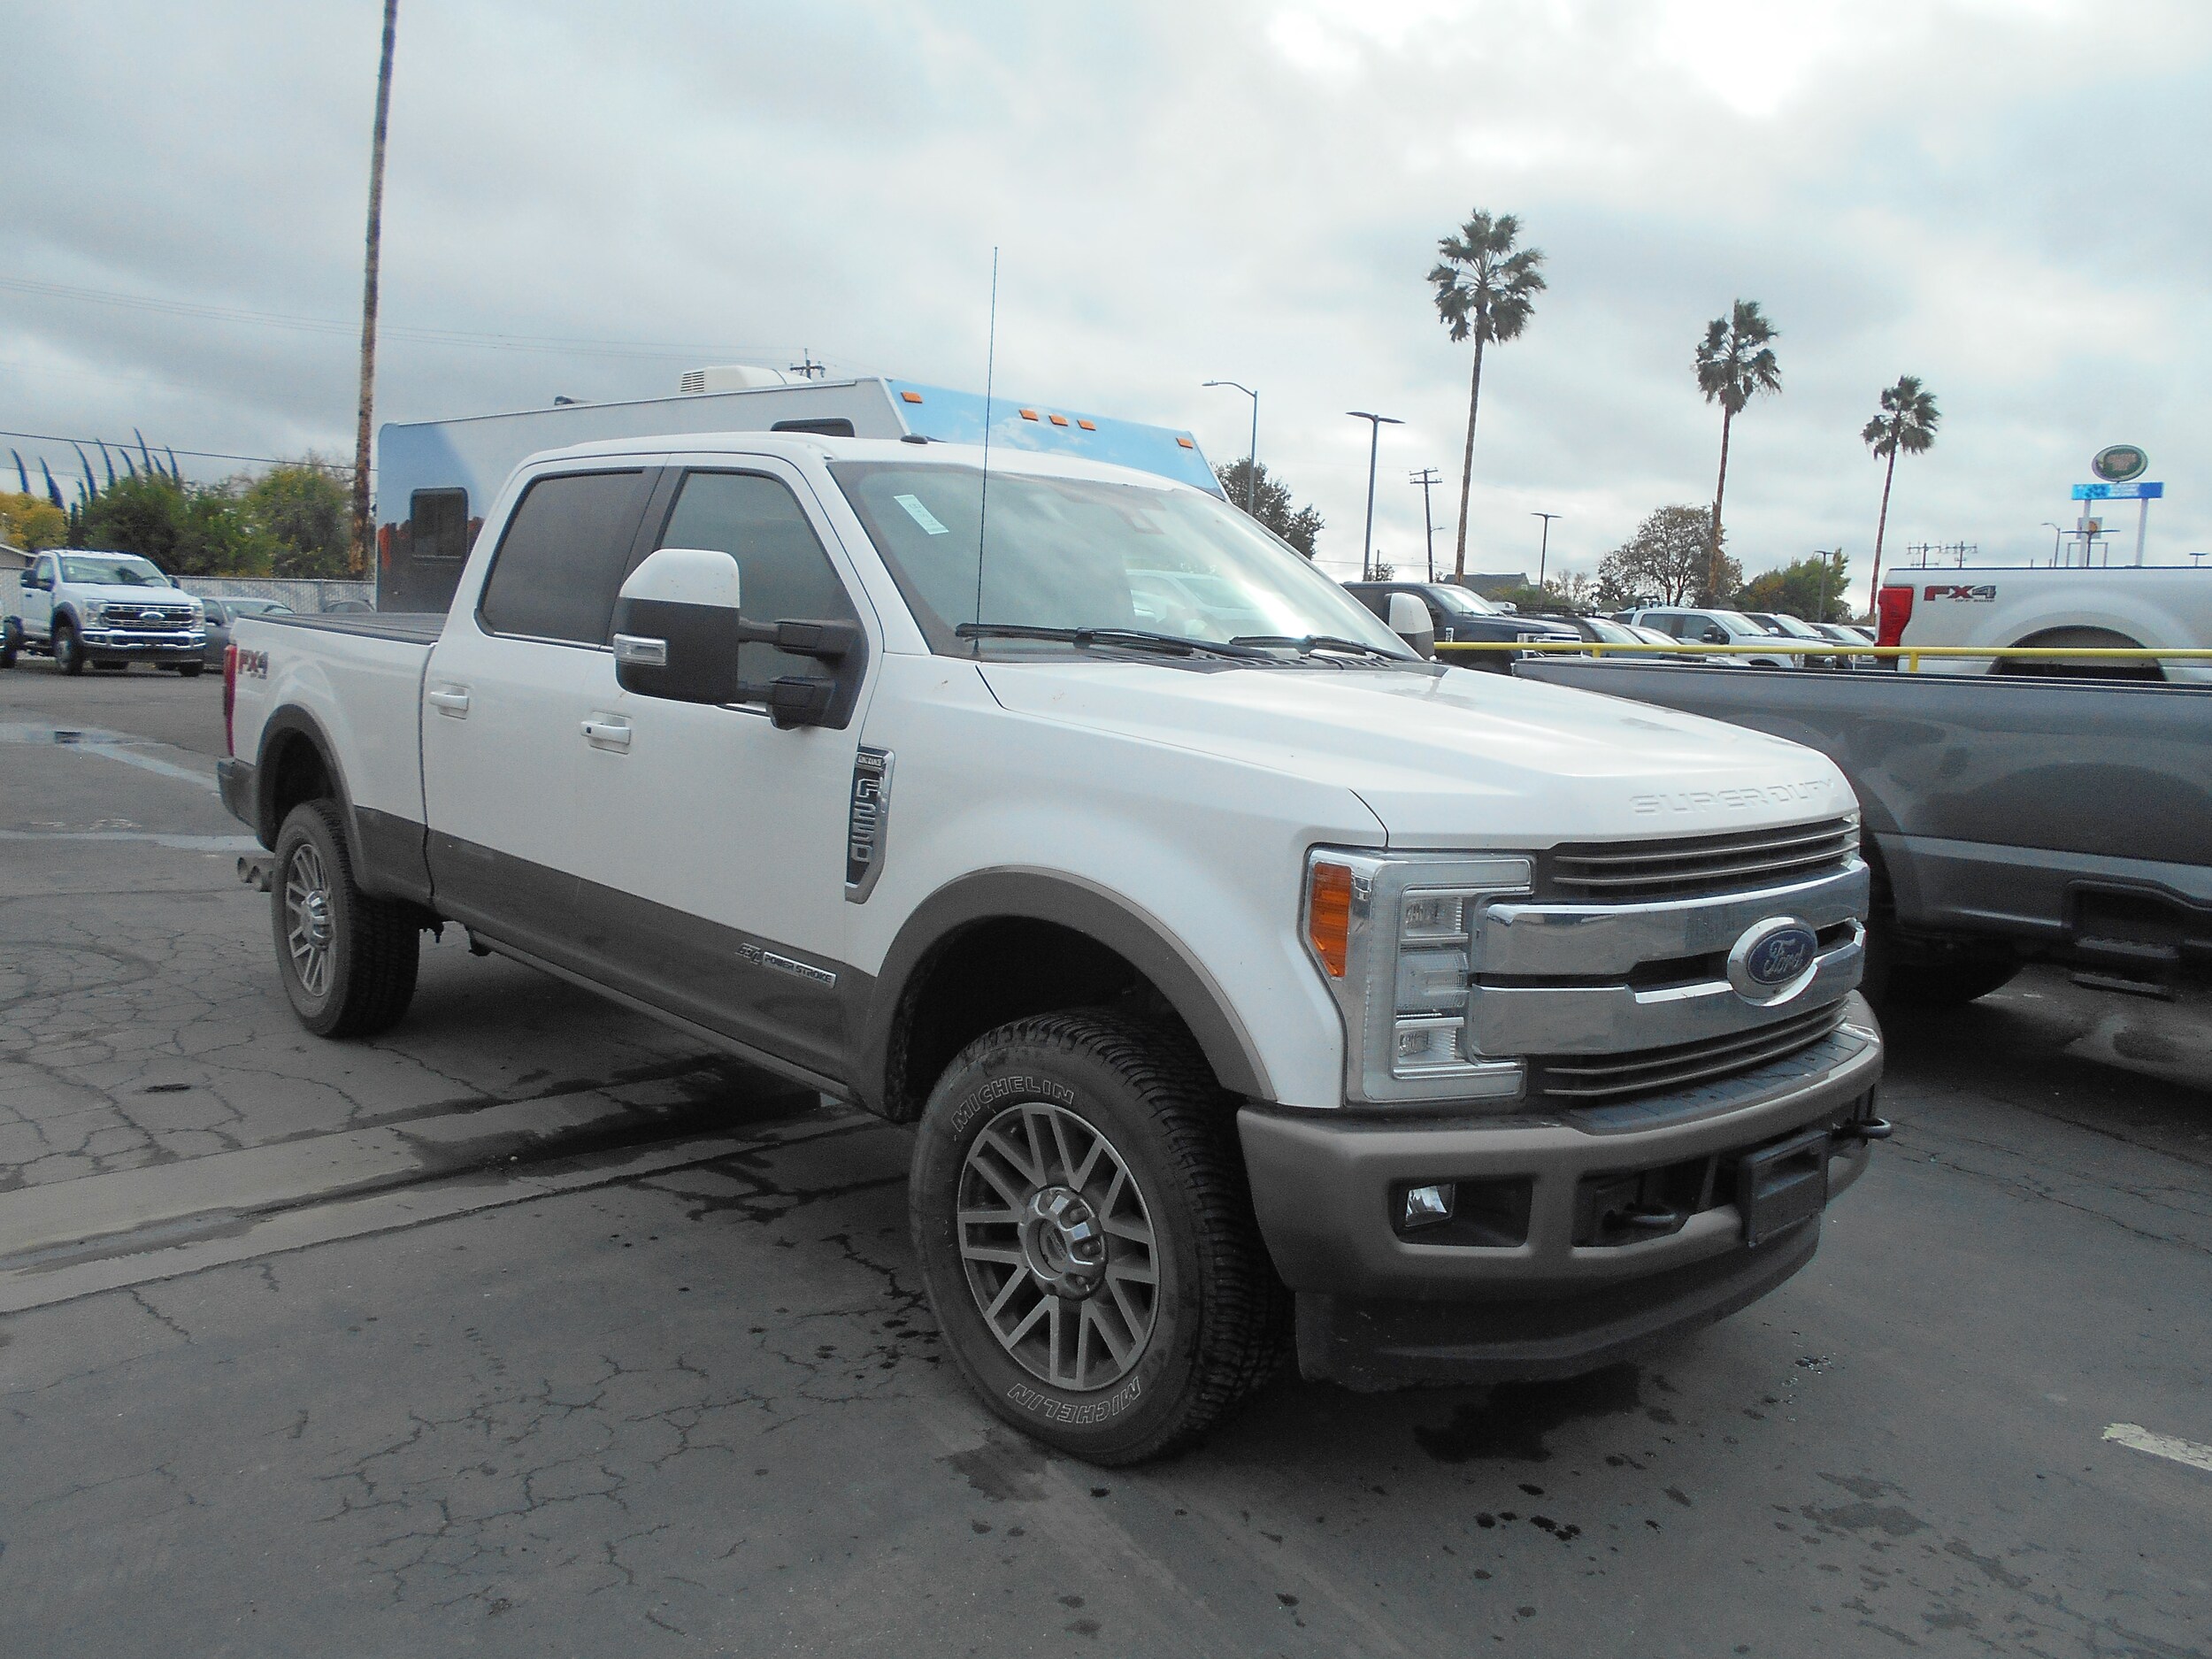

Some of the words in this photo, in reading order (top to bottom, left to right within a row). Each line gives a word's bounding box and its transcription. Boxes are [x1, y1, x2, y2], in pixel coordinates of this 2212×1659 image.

[1924, 585, 1996, 601] FX4
[238, 649, 268, 674] FX4
[764, 955, 795, 971] POWER
[796, 964, 832, 983] STROKE
[1763, 938, 1805, 977] Ford
[951, 1076, 1074, 1133] MICHELIN
[1007, 1376, 1141, 1424] MICHELIN
